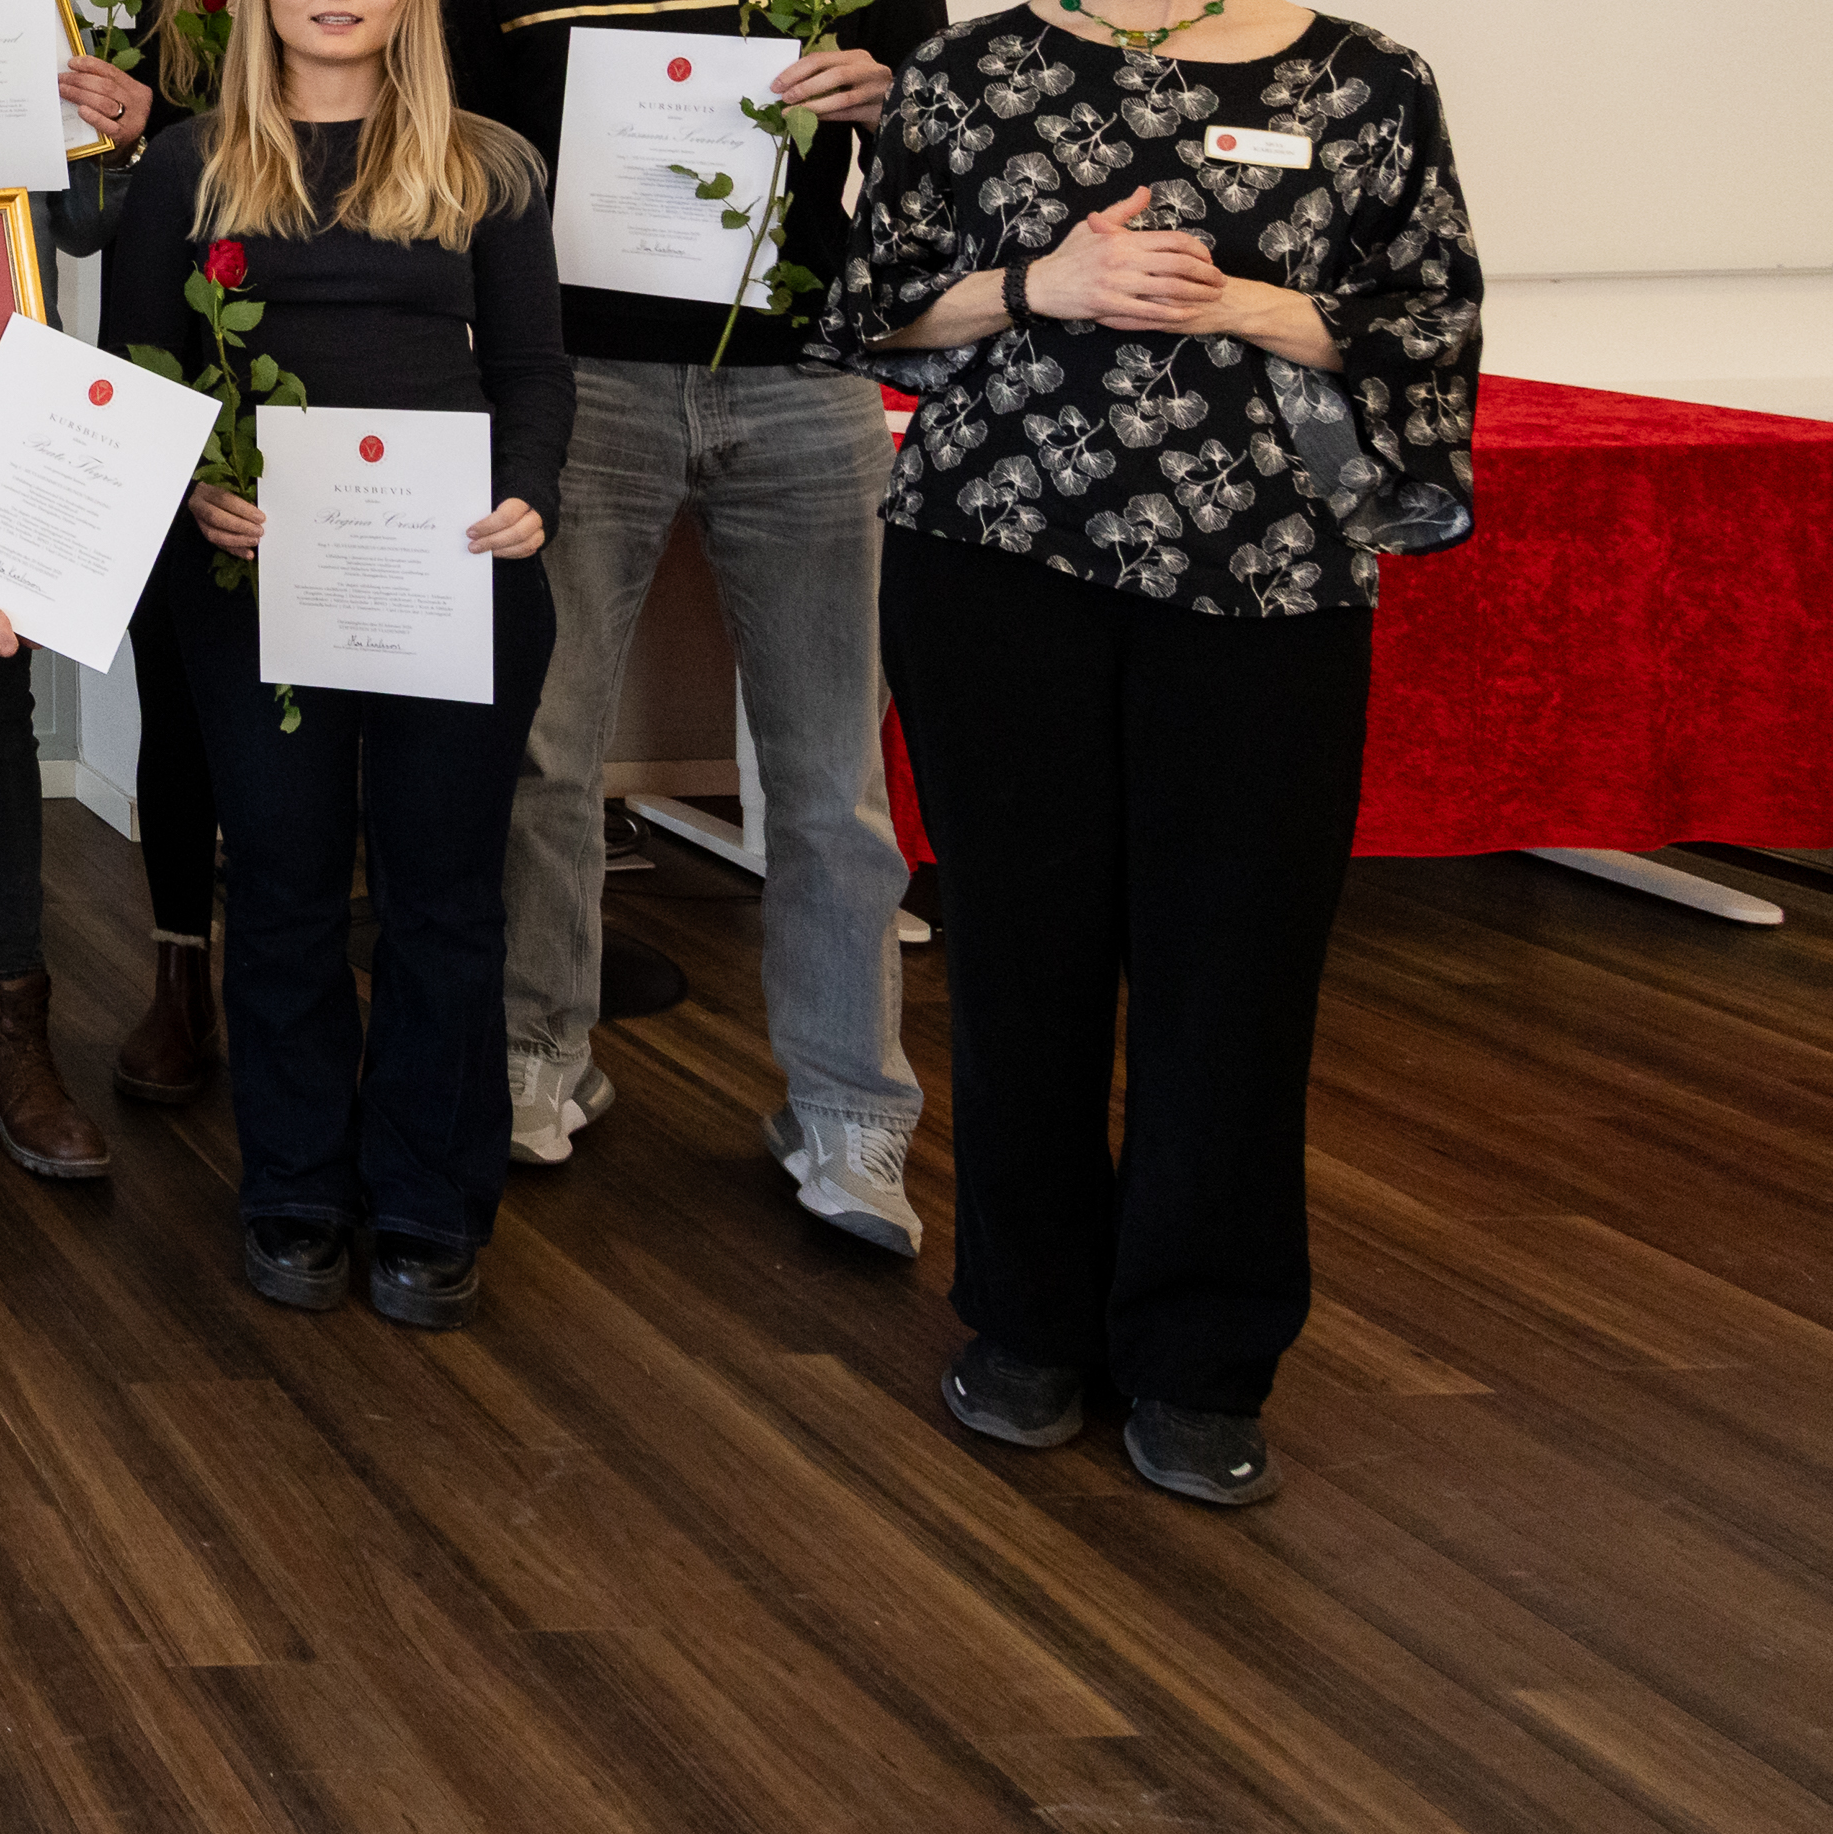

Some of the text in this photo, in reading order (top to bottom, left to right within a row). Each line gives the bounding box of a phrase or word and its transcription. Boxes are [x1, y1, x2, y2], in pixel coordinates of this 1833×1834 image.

[638, 101, 717, 114] KURSBEVIS
[49, 411, 122, 450] KURSBEVIS
[333, 483, 413, 496] KURSBEVIS
[314, 508, 373, 531] Regina
